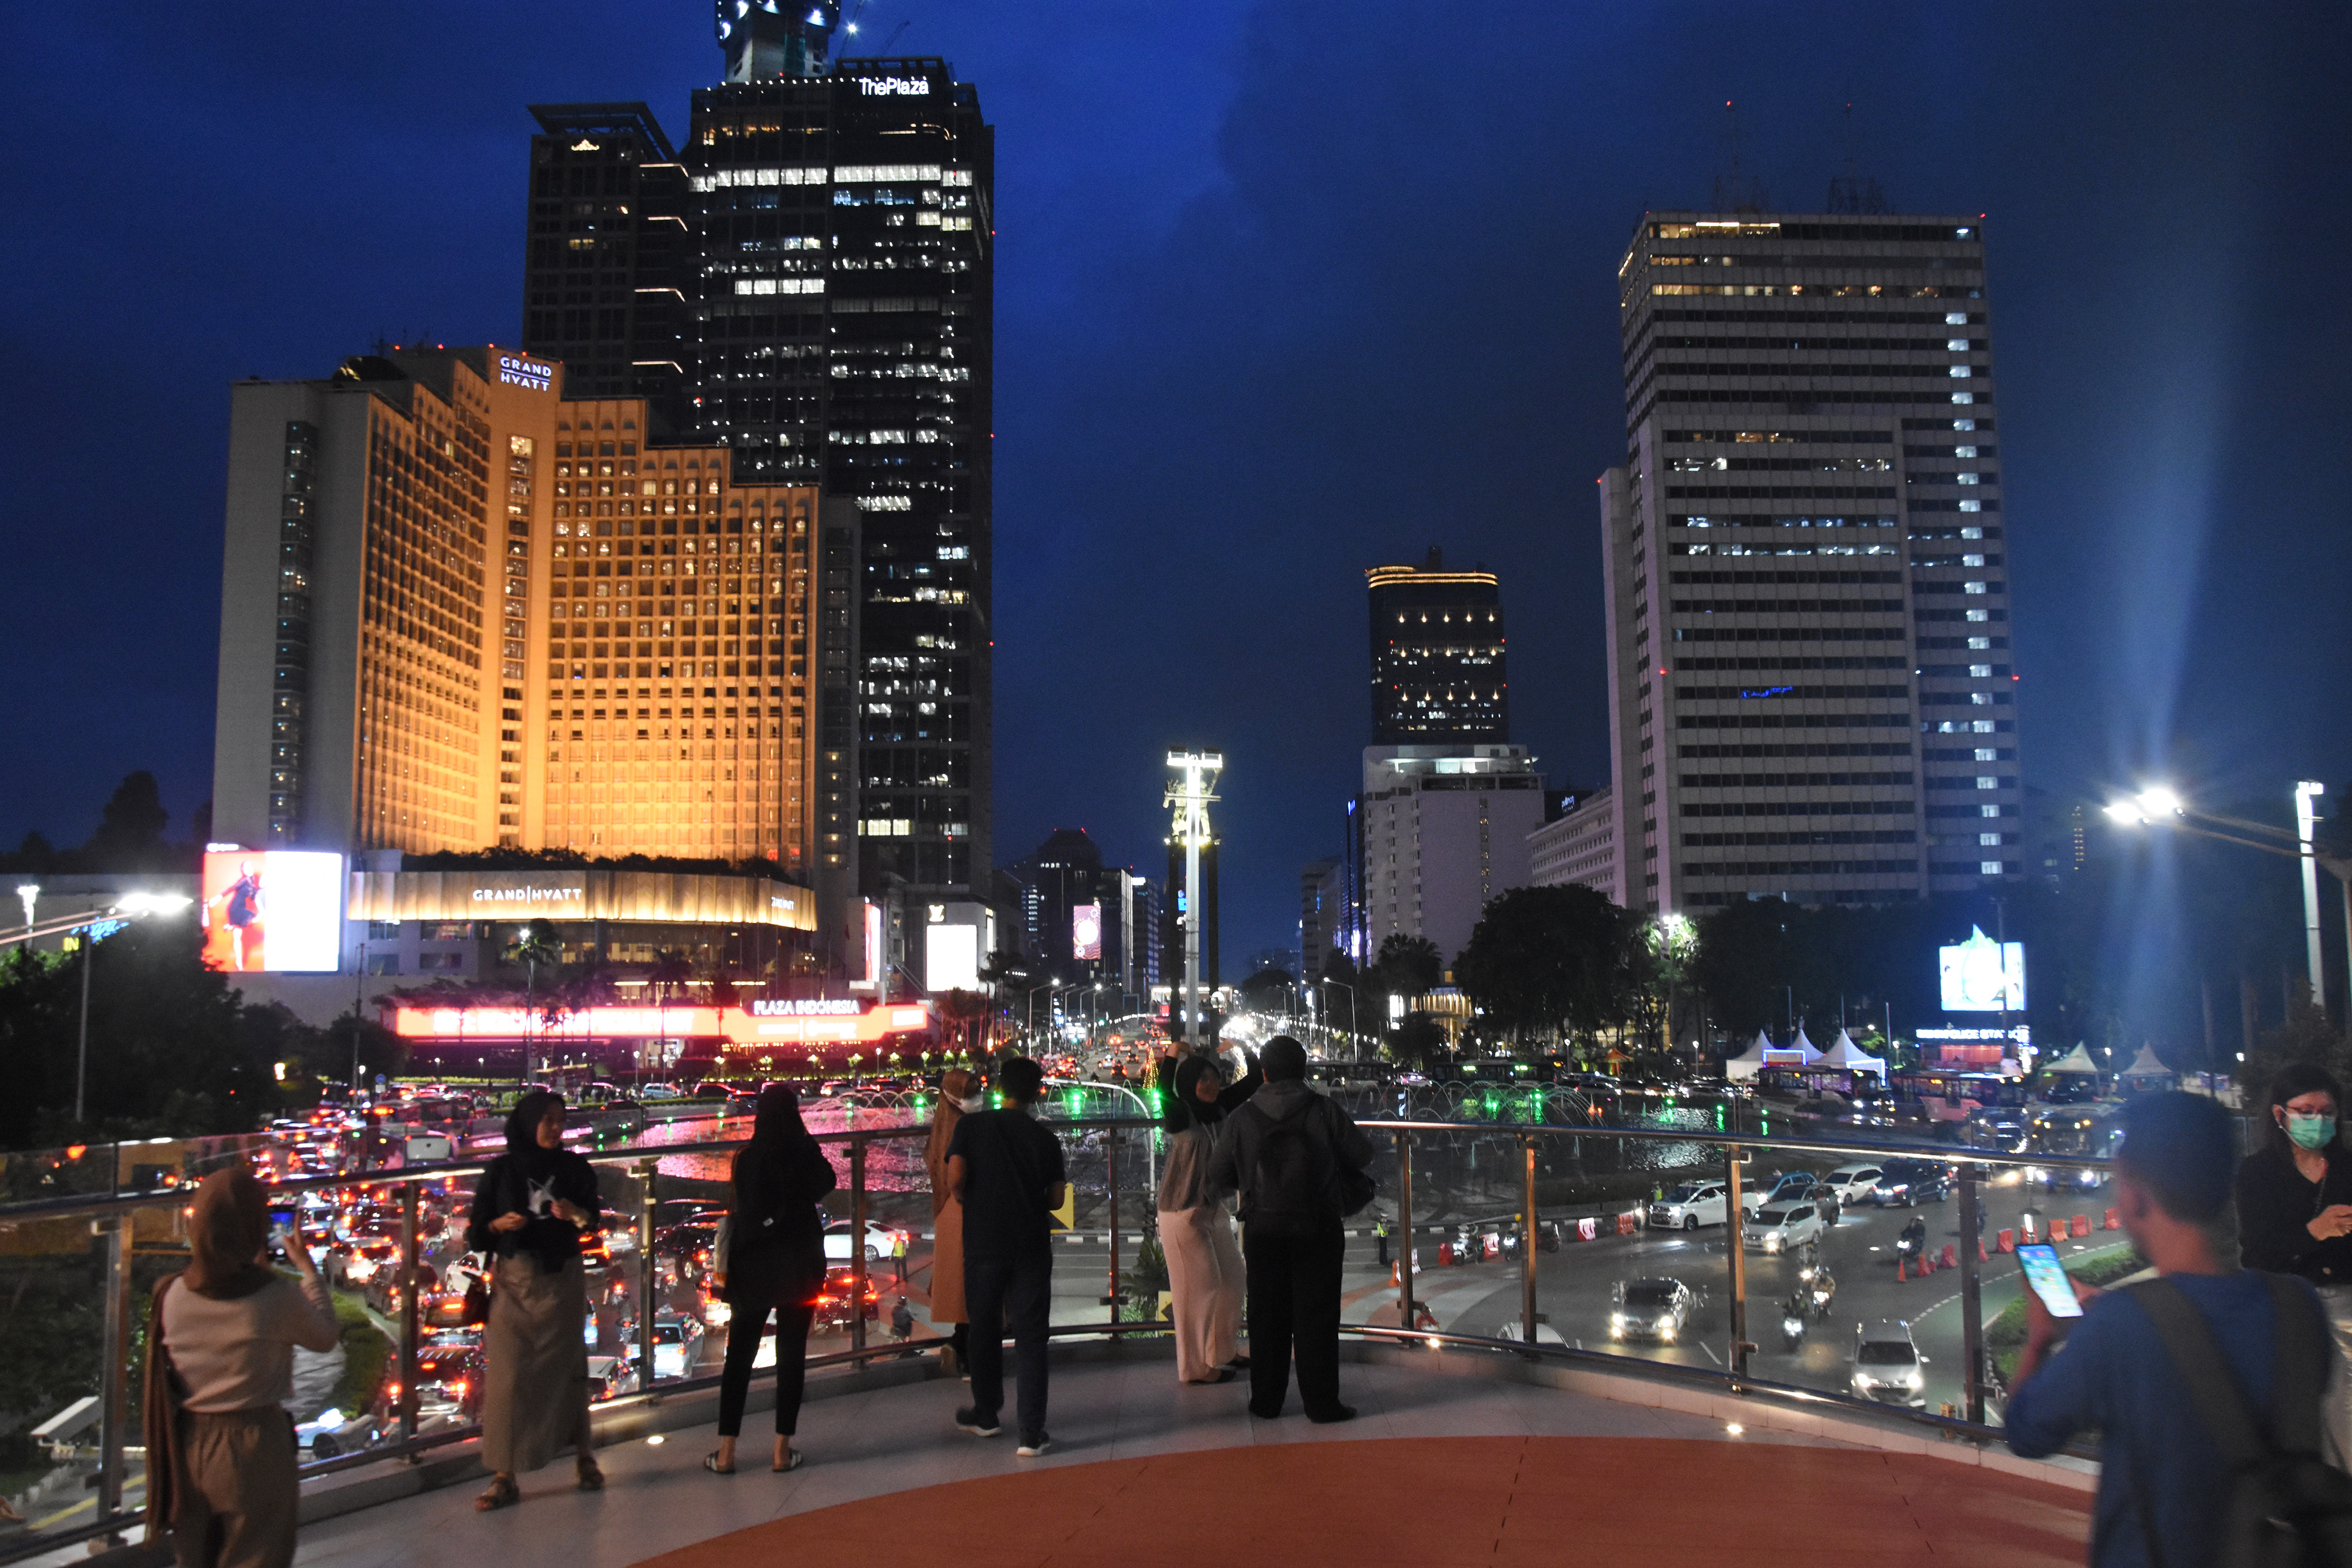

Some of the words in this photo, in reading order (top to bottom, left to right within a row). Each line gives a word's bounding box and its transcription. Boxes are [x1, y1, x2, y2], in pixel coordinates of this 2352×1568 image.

[858, 77, 929, 96] ThePlaza
[500, 356, 552, 377] GRAND
[500, 372, 550, 392] HYATT
[473, 889, 526, 901] GRAND
[532, 889, 582, 901] HYATT
[753, 1001, 794, 1015] PLAZA
[796, 1000, 860, 1015] INDONESIA
